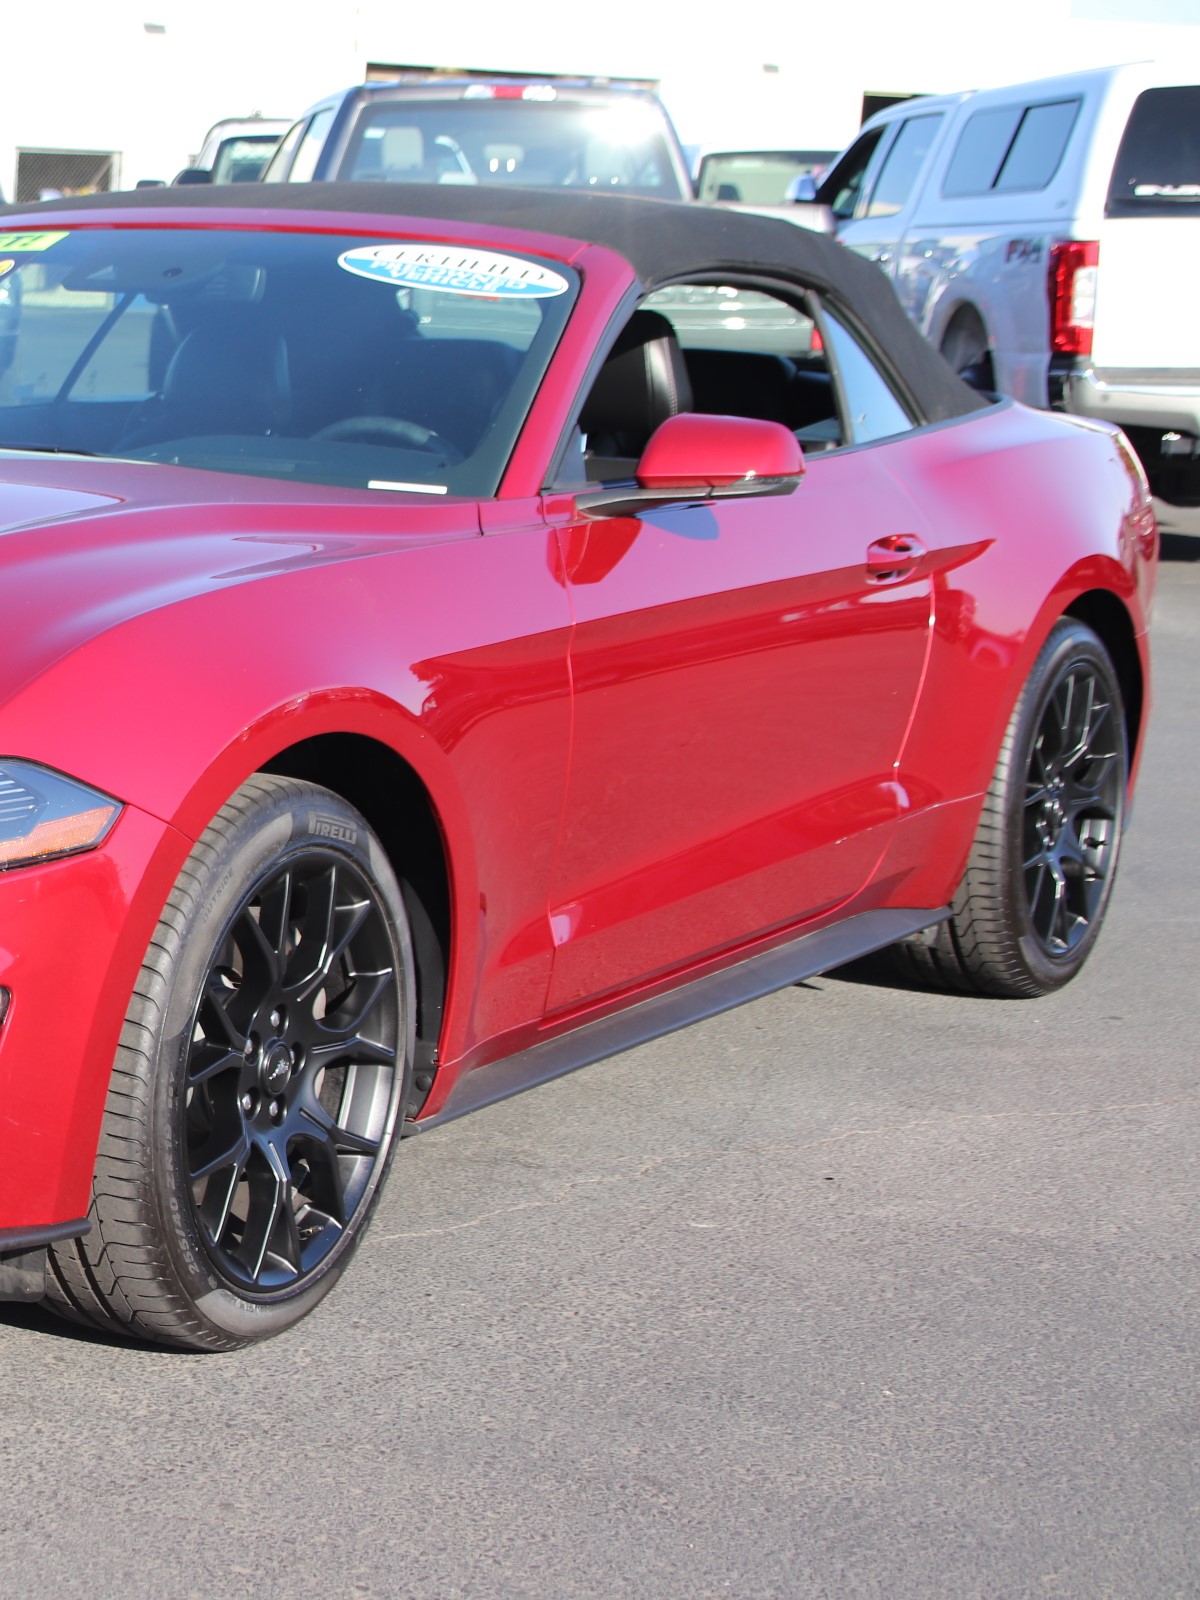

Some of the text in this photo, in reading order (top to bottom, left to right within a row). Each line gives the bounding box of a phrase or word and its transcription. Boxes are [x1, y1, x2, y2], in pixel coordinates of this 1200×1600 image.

[308, 811, 358, 845] PIRELLI
[201, 867, 235, 923] OUTSIDE
[168, 1196, 201, 1277] 255/40
